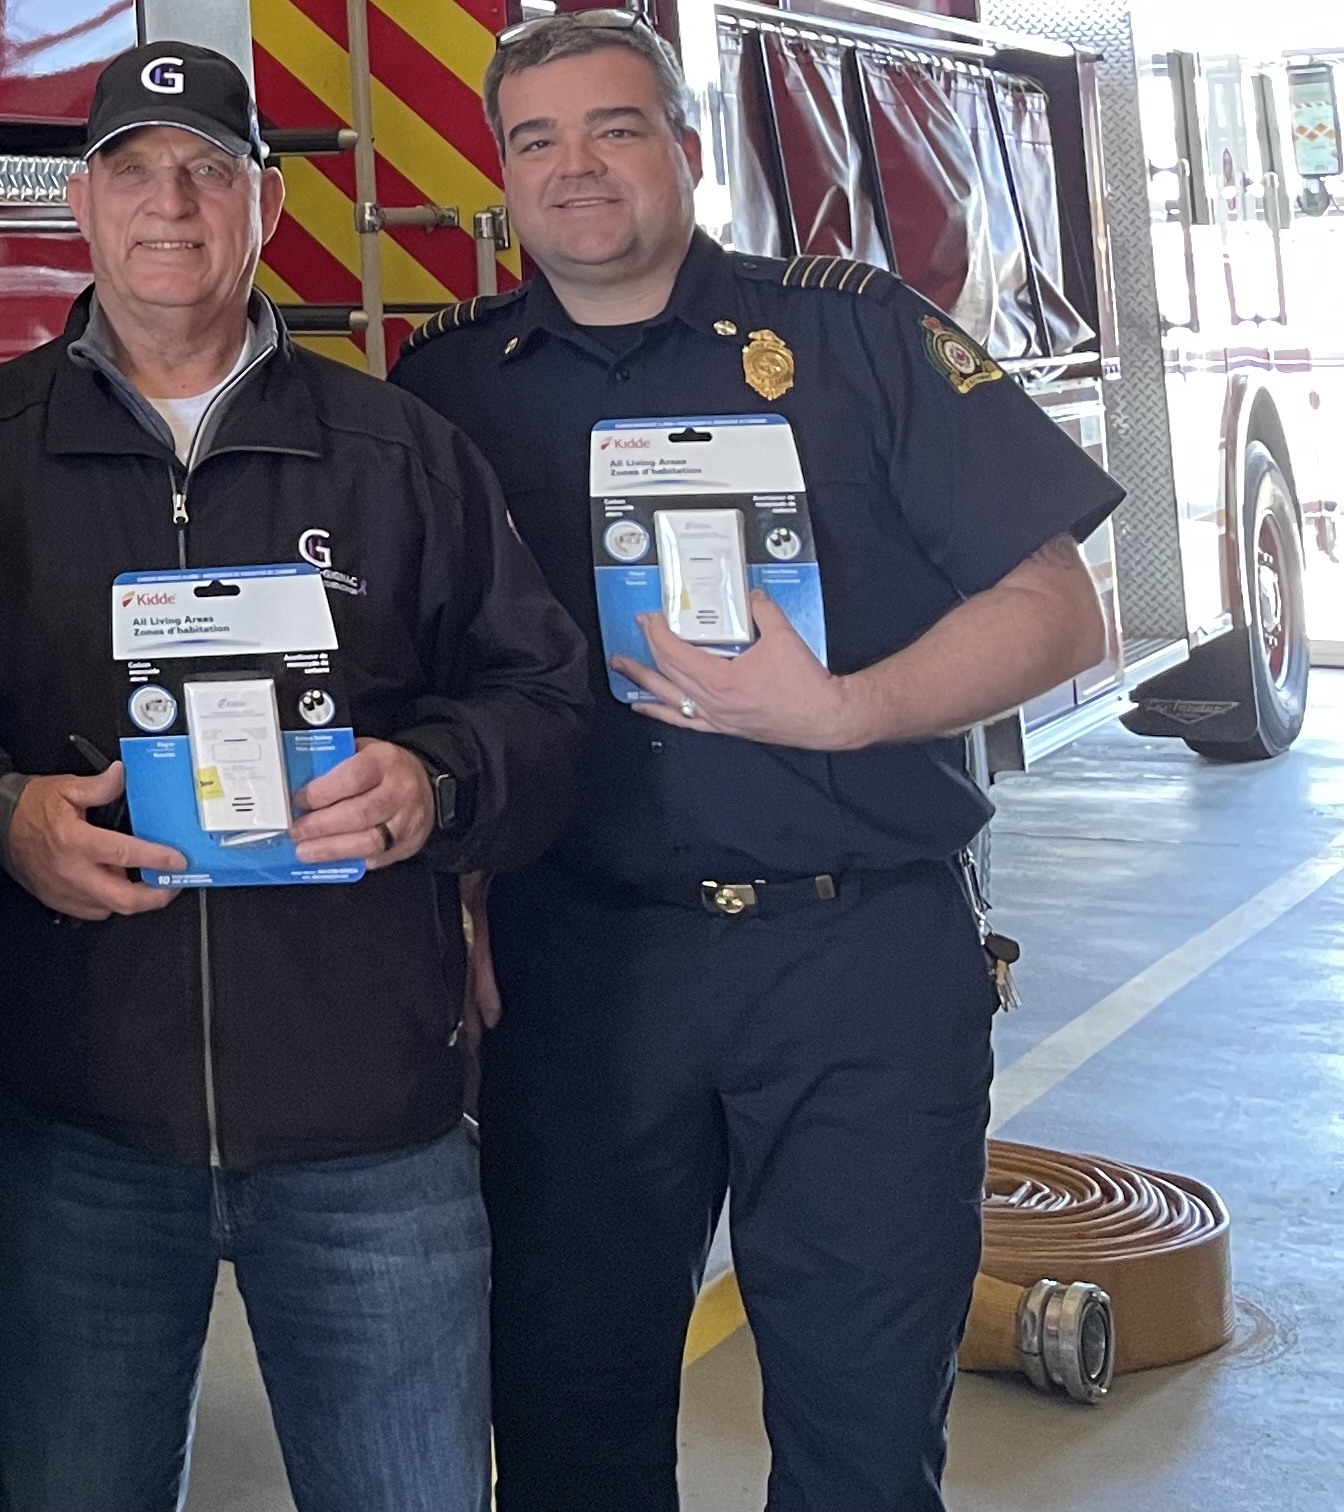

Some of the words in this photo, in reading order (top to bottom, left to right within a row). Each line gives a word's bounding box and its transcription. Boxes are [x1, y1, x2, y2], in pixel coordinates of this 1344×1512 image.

[141, 57, 185, 94] G
[614, 438, 650, 449] Kidde
[298, 529, 332, 568] G
[137, 593, 176, 606] Kidde
[133, 617, 147, 626] All
[150, 616, 181, 626] Living
[134, 628, 164, 636] Zones
